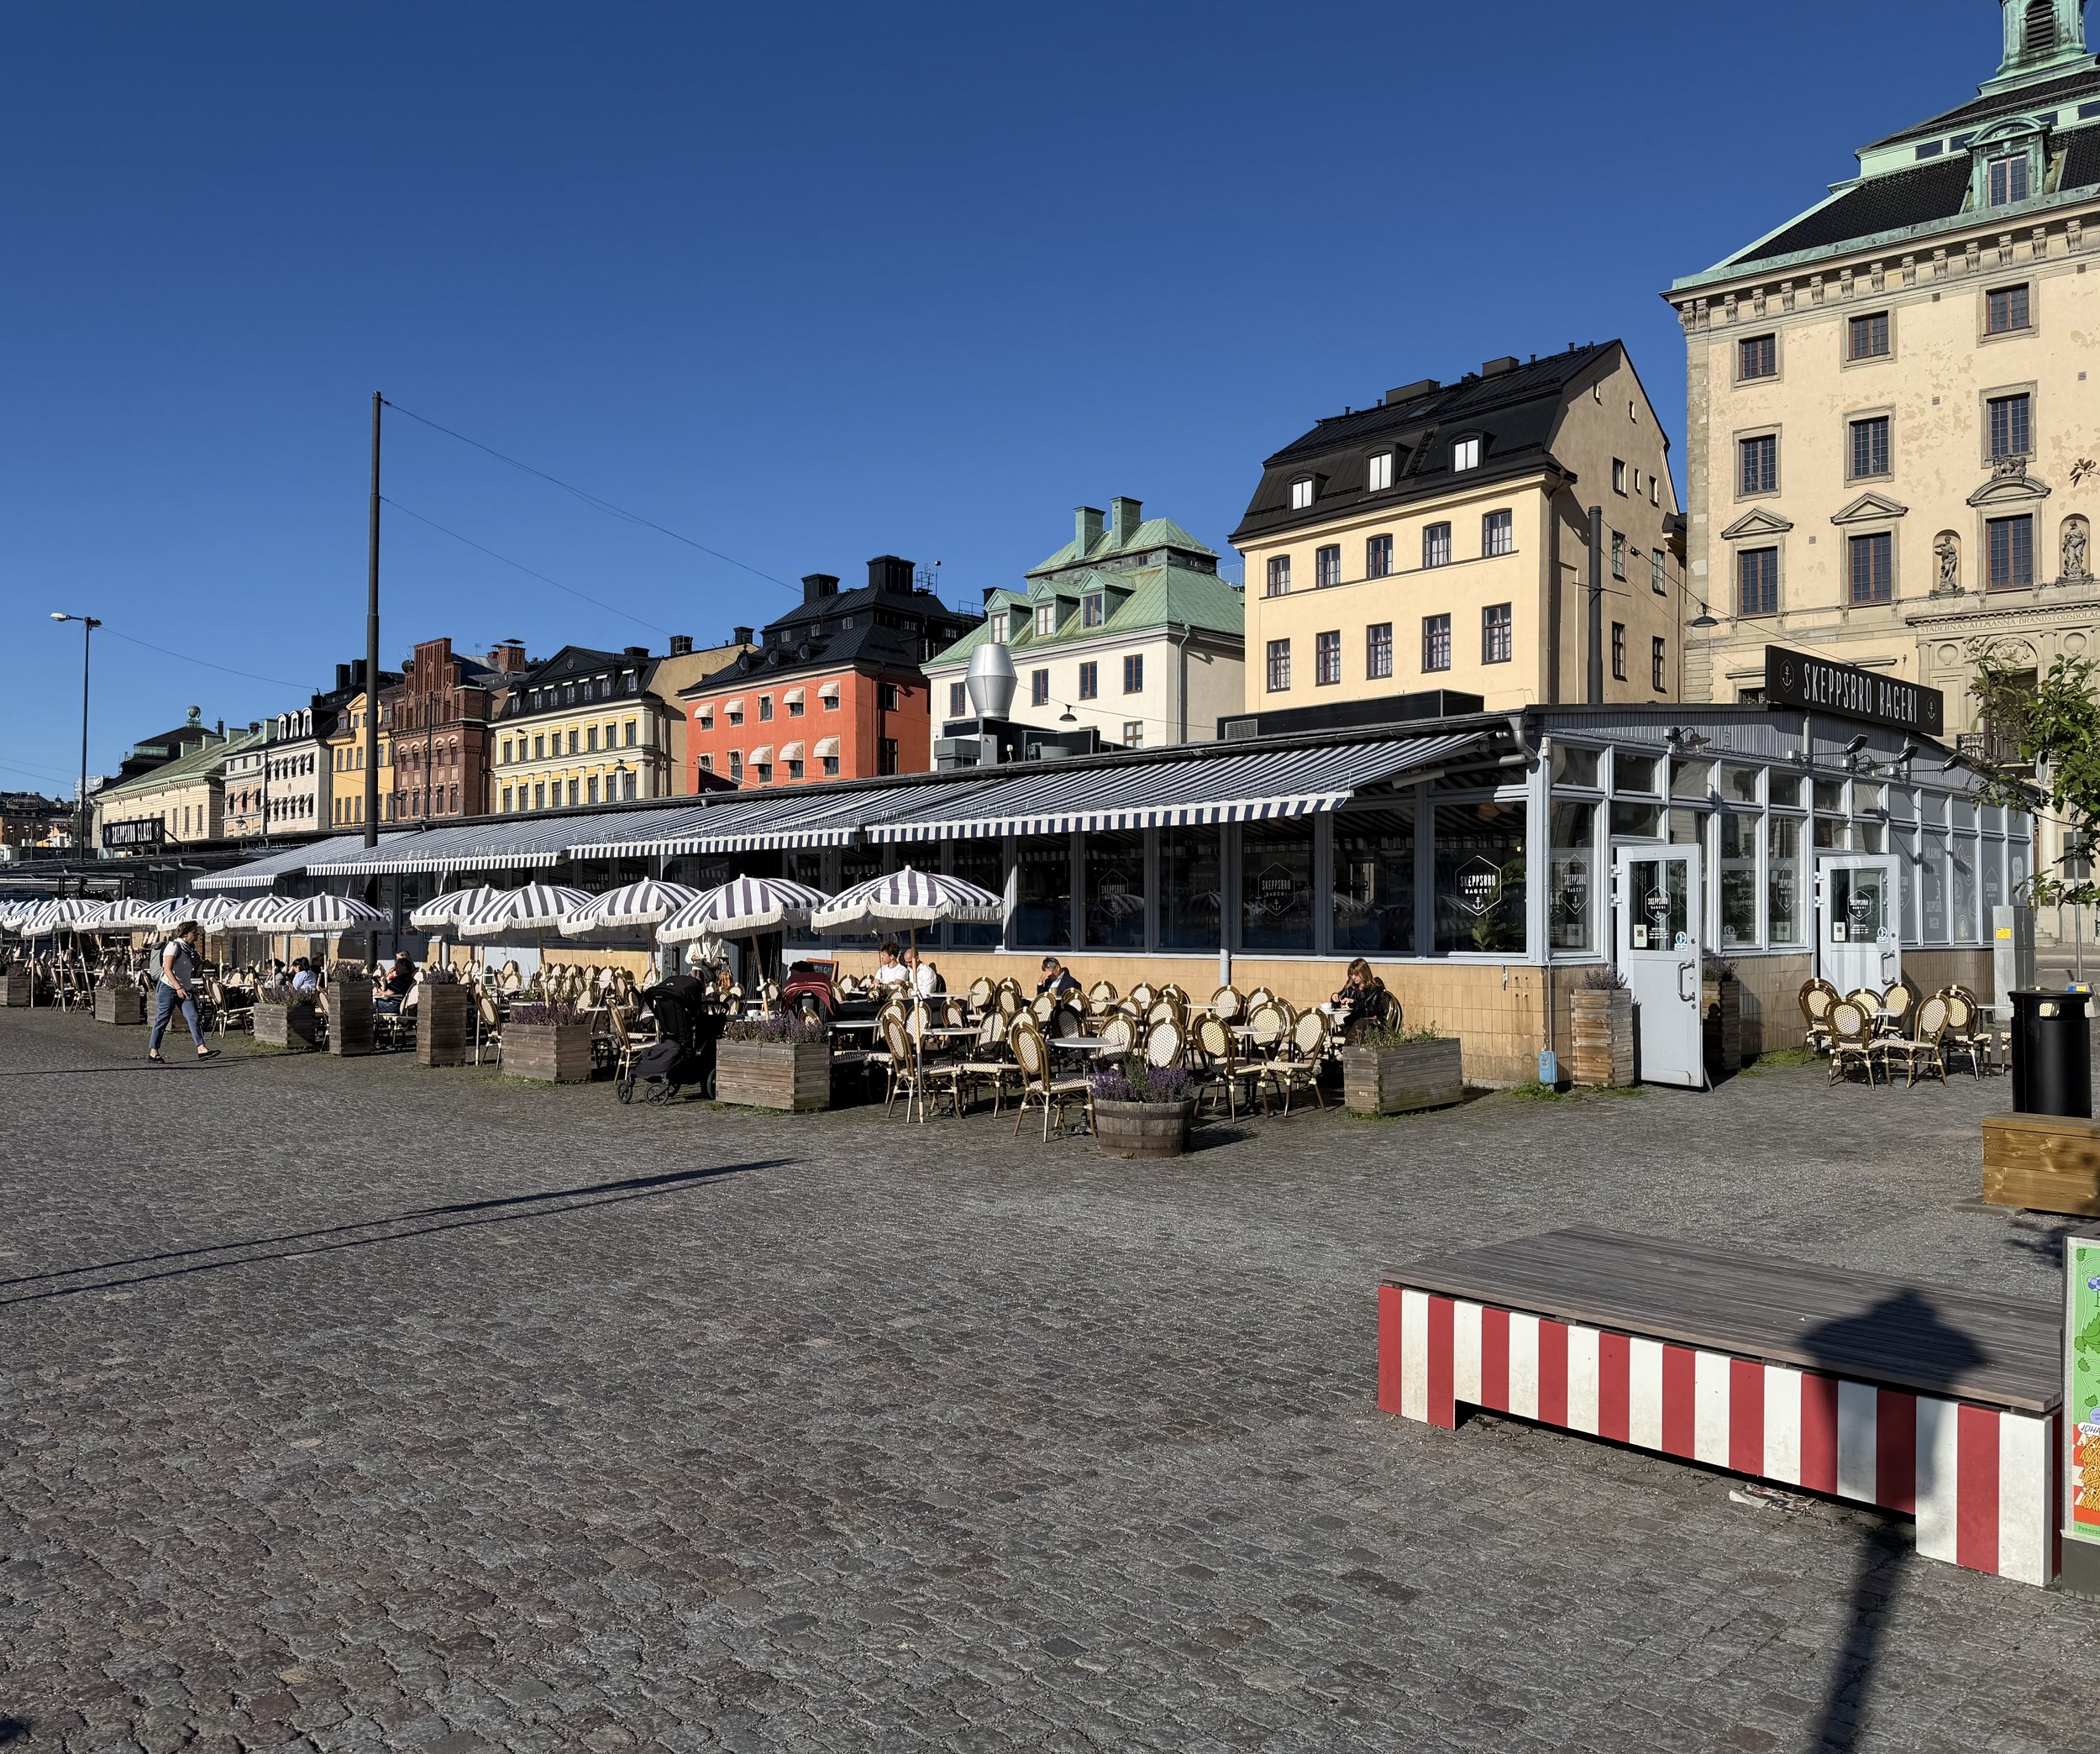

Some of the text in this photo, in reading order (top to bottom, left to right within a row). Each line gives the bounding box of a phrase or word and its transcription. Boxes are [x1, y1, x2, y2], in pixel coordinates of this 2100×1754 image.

[1803, 662, 1918, 724] SKEPPSBRO BAGERI
[137, 822, 152, 842] GLASS
[1262, 880, 1291, 890] SKEPPSBRO
[1460, 874, 1495, 886] SKEPPSBRO
